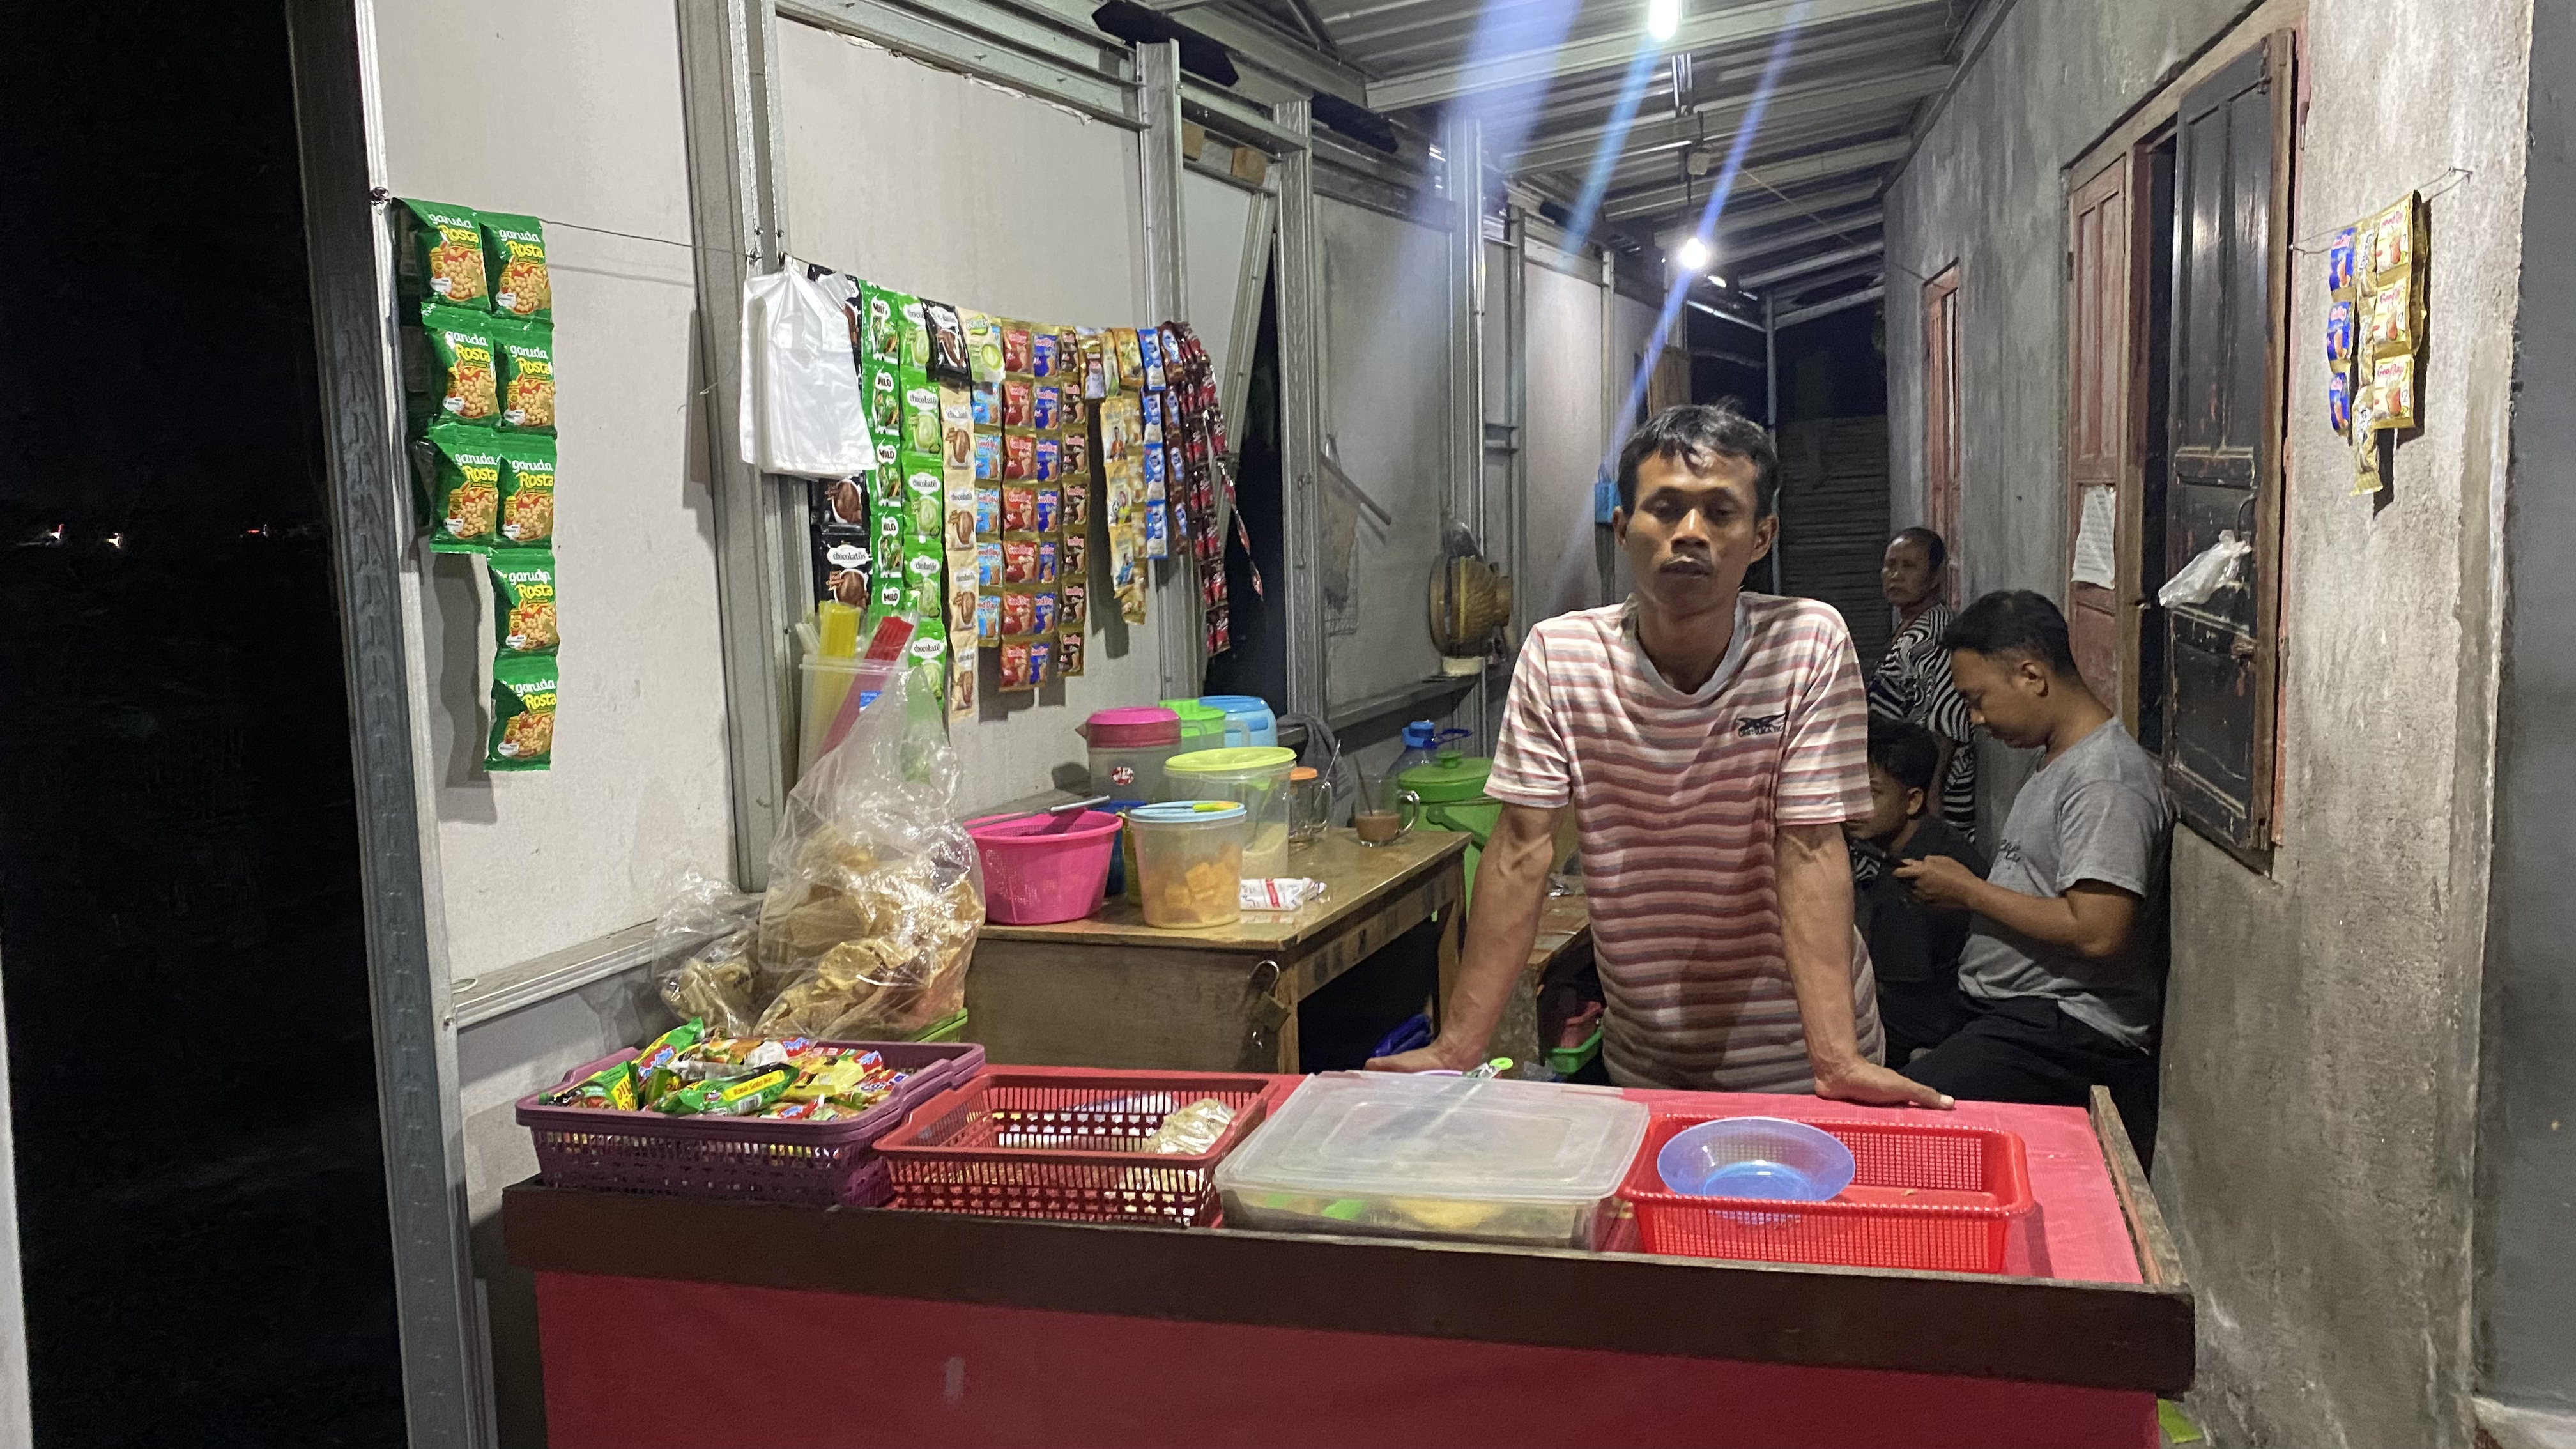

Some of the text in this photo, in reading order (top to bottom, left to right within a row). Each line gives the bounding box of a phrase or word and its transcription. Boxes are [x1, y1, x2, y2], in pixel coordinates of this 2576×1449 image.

[428, 213, 475, 228] garuda
[437, 224, 479, 243] Rosta
[499, 228, 540, 243] garuda
[505, 240, 544, 257] Rosta
[445, 330, 488, 346] garuda
[456, 345, 491, 363] Rosta
[509, 344, 549, 360] garuda
[516, 357, 550, 374] Rosta
[455, 453, 496, 465] garuda
[879, 448, 894, 459] MILO
[462, 465, 498, 482] Rosta
[512, 459, 553, 472] garuda
[516, 472, 554, 487] Rosta
[509, 569, 551, 585] garuda
[515, 584, 553, 599] Rosta
[515, 678, 556, 697] garuda
[521, 693, 556, 709] Rosta
